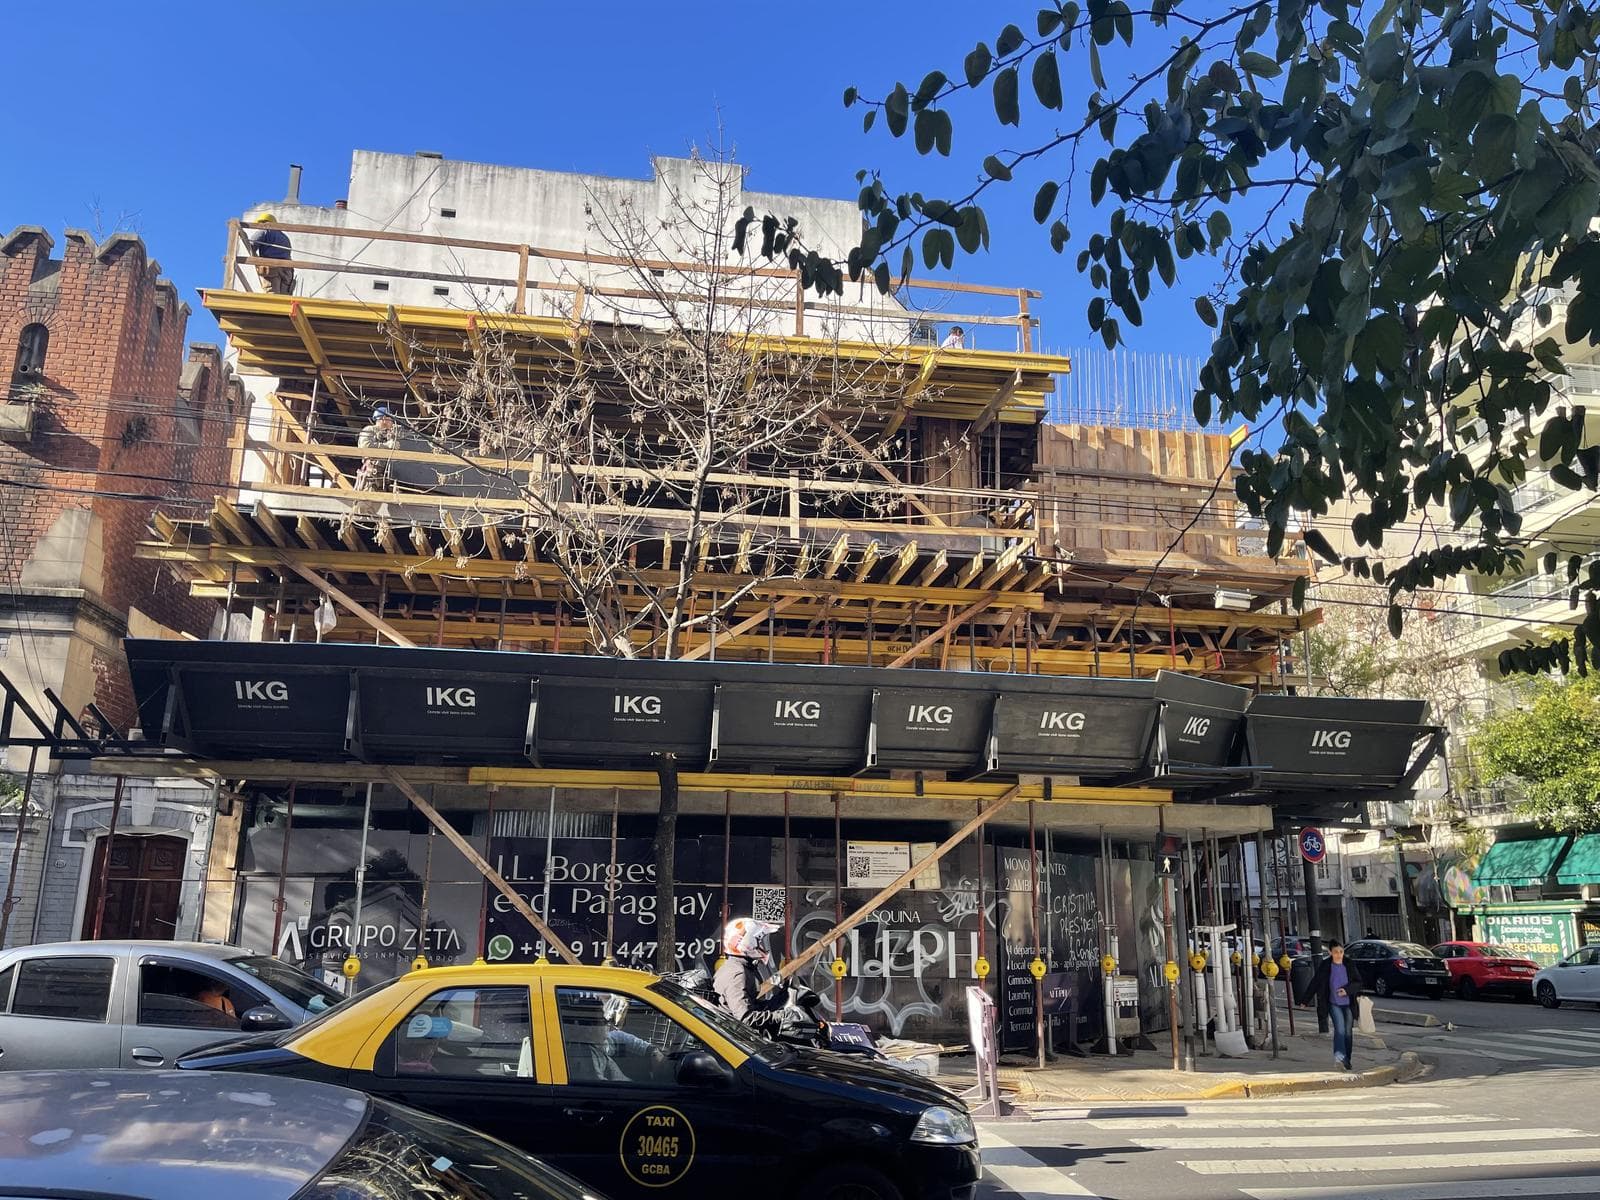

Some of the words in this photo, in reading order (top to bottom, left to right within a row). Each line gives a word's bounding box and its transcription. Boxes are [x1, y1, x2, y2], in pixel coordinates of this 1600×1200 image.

[235, 680, 289, 701] IKG
[426, 687, 476, 707] IKG
[614, 695, 662, 714] IKG
[775, 700, 821, 719] IKG
[908, 705, 953, 724] IKG
[1040, 711, 1086, 730] IKG
[1183, 716, 1211, 736] IKG
[1311, 730, 1352, 748] IKG
[550, 856, 658, 892] Borges
[571, 888, 713, 925] Paragay
[1053, 891, 1096, 914] CRISTINA
[310, 924, 396, 949] GRUPO
[403, 927, 461, 950] ZETA
[309, 951, 369, 961] SERVICOS
[571, 941, 584, 957] 9
[592, 941, 608, 957] 11
[645, 1116, 675, 1127] TAXI
[637, 1135, 679, 1157] 30465
[641, 1163, 670, 1175] GCBA
